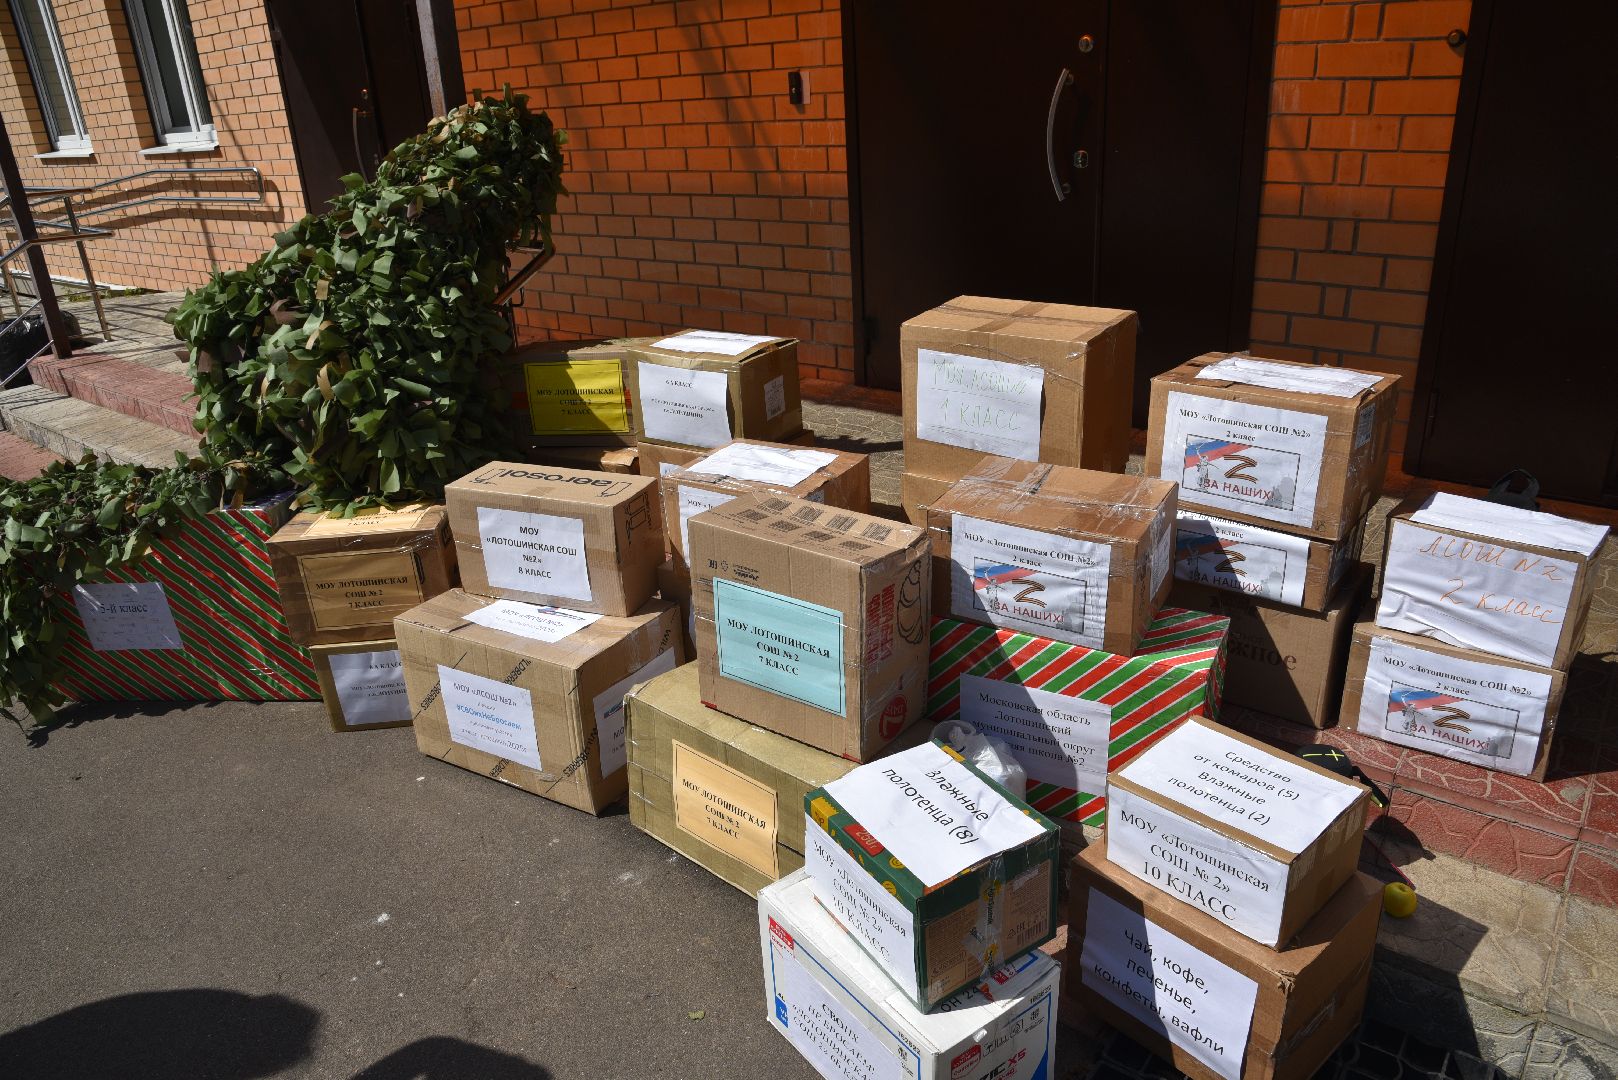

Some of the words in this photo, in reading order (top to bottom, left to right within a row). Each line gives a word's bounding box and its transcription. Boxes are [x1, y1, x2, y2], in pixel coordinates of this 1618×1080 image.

[554, 388, 615, 396] ЛОТОШИНСКАЯ
[960, 402, 1021, 431] КЛАСС
[1178, 408, 1200, 419] МОУ
[1201, 413, 1262, 431] «Лотошинская
[1264, 424, 1289, 436] СОШ
[1290, 428, 1311, 439] №2»
[1226, 430, 1231, 438] 2
[1232, 433, 1256, 442] класс
[500, 468, 613, 487] aerosol
[1203, 479, 1219, 490] ЗА
[1223, 481, 1275, 501] НАШИХ!
[519, 526, 540, 536] МОУ
[1215, 526, 1220, 534] 2
[1221, 529, 1244, 540] класс
[486, 536, 556, 552] «ЛОТОШИНСКАЯ
[556, 546, 578, 556] СОШ
[522, 554, 542, 564] №2»
[964, 532, 985, 543] МОУ
[987, 537, 1048, 557] «Лотошинская
[1049, 549, 1074, 563] СОШ
[1075, 557, 1096, 568] №2»
[524, 567, 552, 579] КЛАСС
[1019, 558, 1043, 568] класс
[316, 582, 336, 590] МОУ
[338, 576, 408, 589] ЛОТОШИНСКАЯ
[344, 590, 368, 599] СОШ
[119, 604, 149, 613] класс
[353, 599, 385, 609] КЛАСС
[1013, 606, 1064, 624] НАШИХ!
[1439, 578, 1464, 605] 2
[1475, 592, 1562, 625] класс
[727, 618, 749, 632] МОУ
[750, 626, 831, 659] ЛОТОШИНСКАЯ
[756, 641, 780, 656] СОШ
[793, 653, 800, 662] 2
[765, 657, 799, 676] КЛАСС
[1383, 656, 1408, 668] МОУ
[1408, 664, 1478, 686] «Лотошинская
[1480, 680, 1508, 692] СОШ
[1509, 685, 1533, 696] №2»
[453, 682, 470, 692] МОУ
[1435, 681, 1442, 690] 2
[1443, 685, 1471, 696] класс
[979, 692, 1044, 716] Московская
[1046, 709, 1091, 726] область
[994, 710, 1072, 737] Лотошинский
[972, 720, 1060, 748] муниципальный
[1063, 741, 1096, 755] округ
[1431, 728, 1491, 751] НАШИХ!
[1028, 745, 1064, 761] школа
[1065, 754, 1086, 767] №2
[1224, 750, 1292, 784] Средство
[1193, 754, 1211, 766] от
[1211, 762, 1276, 792] комаров
[1277, 788, 1301, 801] (5)
[1197, 770, 1267, 805] Влажные
[682, 778, 701, 792] МОУ
[700, 789, 767, 830] ЛОТОШИНСКАЯ
[705, 804, 725, 820] СОШ
[881, 768, 955, 828] полотенца
[948, 825, 980, 845] (8)
[1167, 776, 1247, 816] полотенца
[1247, 810, 1271, 827] (2)
[712, 819, 740, 840] КЛАСС
[1120, 809, 1158, 834] МОУ
[1160, 832, 1270, 893] «Лотошинская
[1150, 843, 1190, 873] СОШ
[1192, 865, 1210, 882] №
[1212, 876, 1232, 893] 2»
[813, 839, 836, 868] МОУ
[837, 868, 907, 938] «Лотошинская
[1142, 861, 1162, 880] 10
[1166, 872, 1238, 921] КЛАСС
[832, 878, 857, 909] СОШ
[871, 916, 884, 934] 2»
[846, 908, 891, 963] КЛАСС
[1123, 929, 1157, 962] Чай,
[1162, 956, 1210, 995] кофе,
[1125, 958, 1197, 1015] печенье,
[1093, 964, 1167, 1020] конфеты,
[1171, 1015, 1225, 1056] вафли
